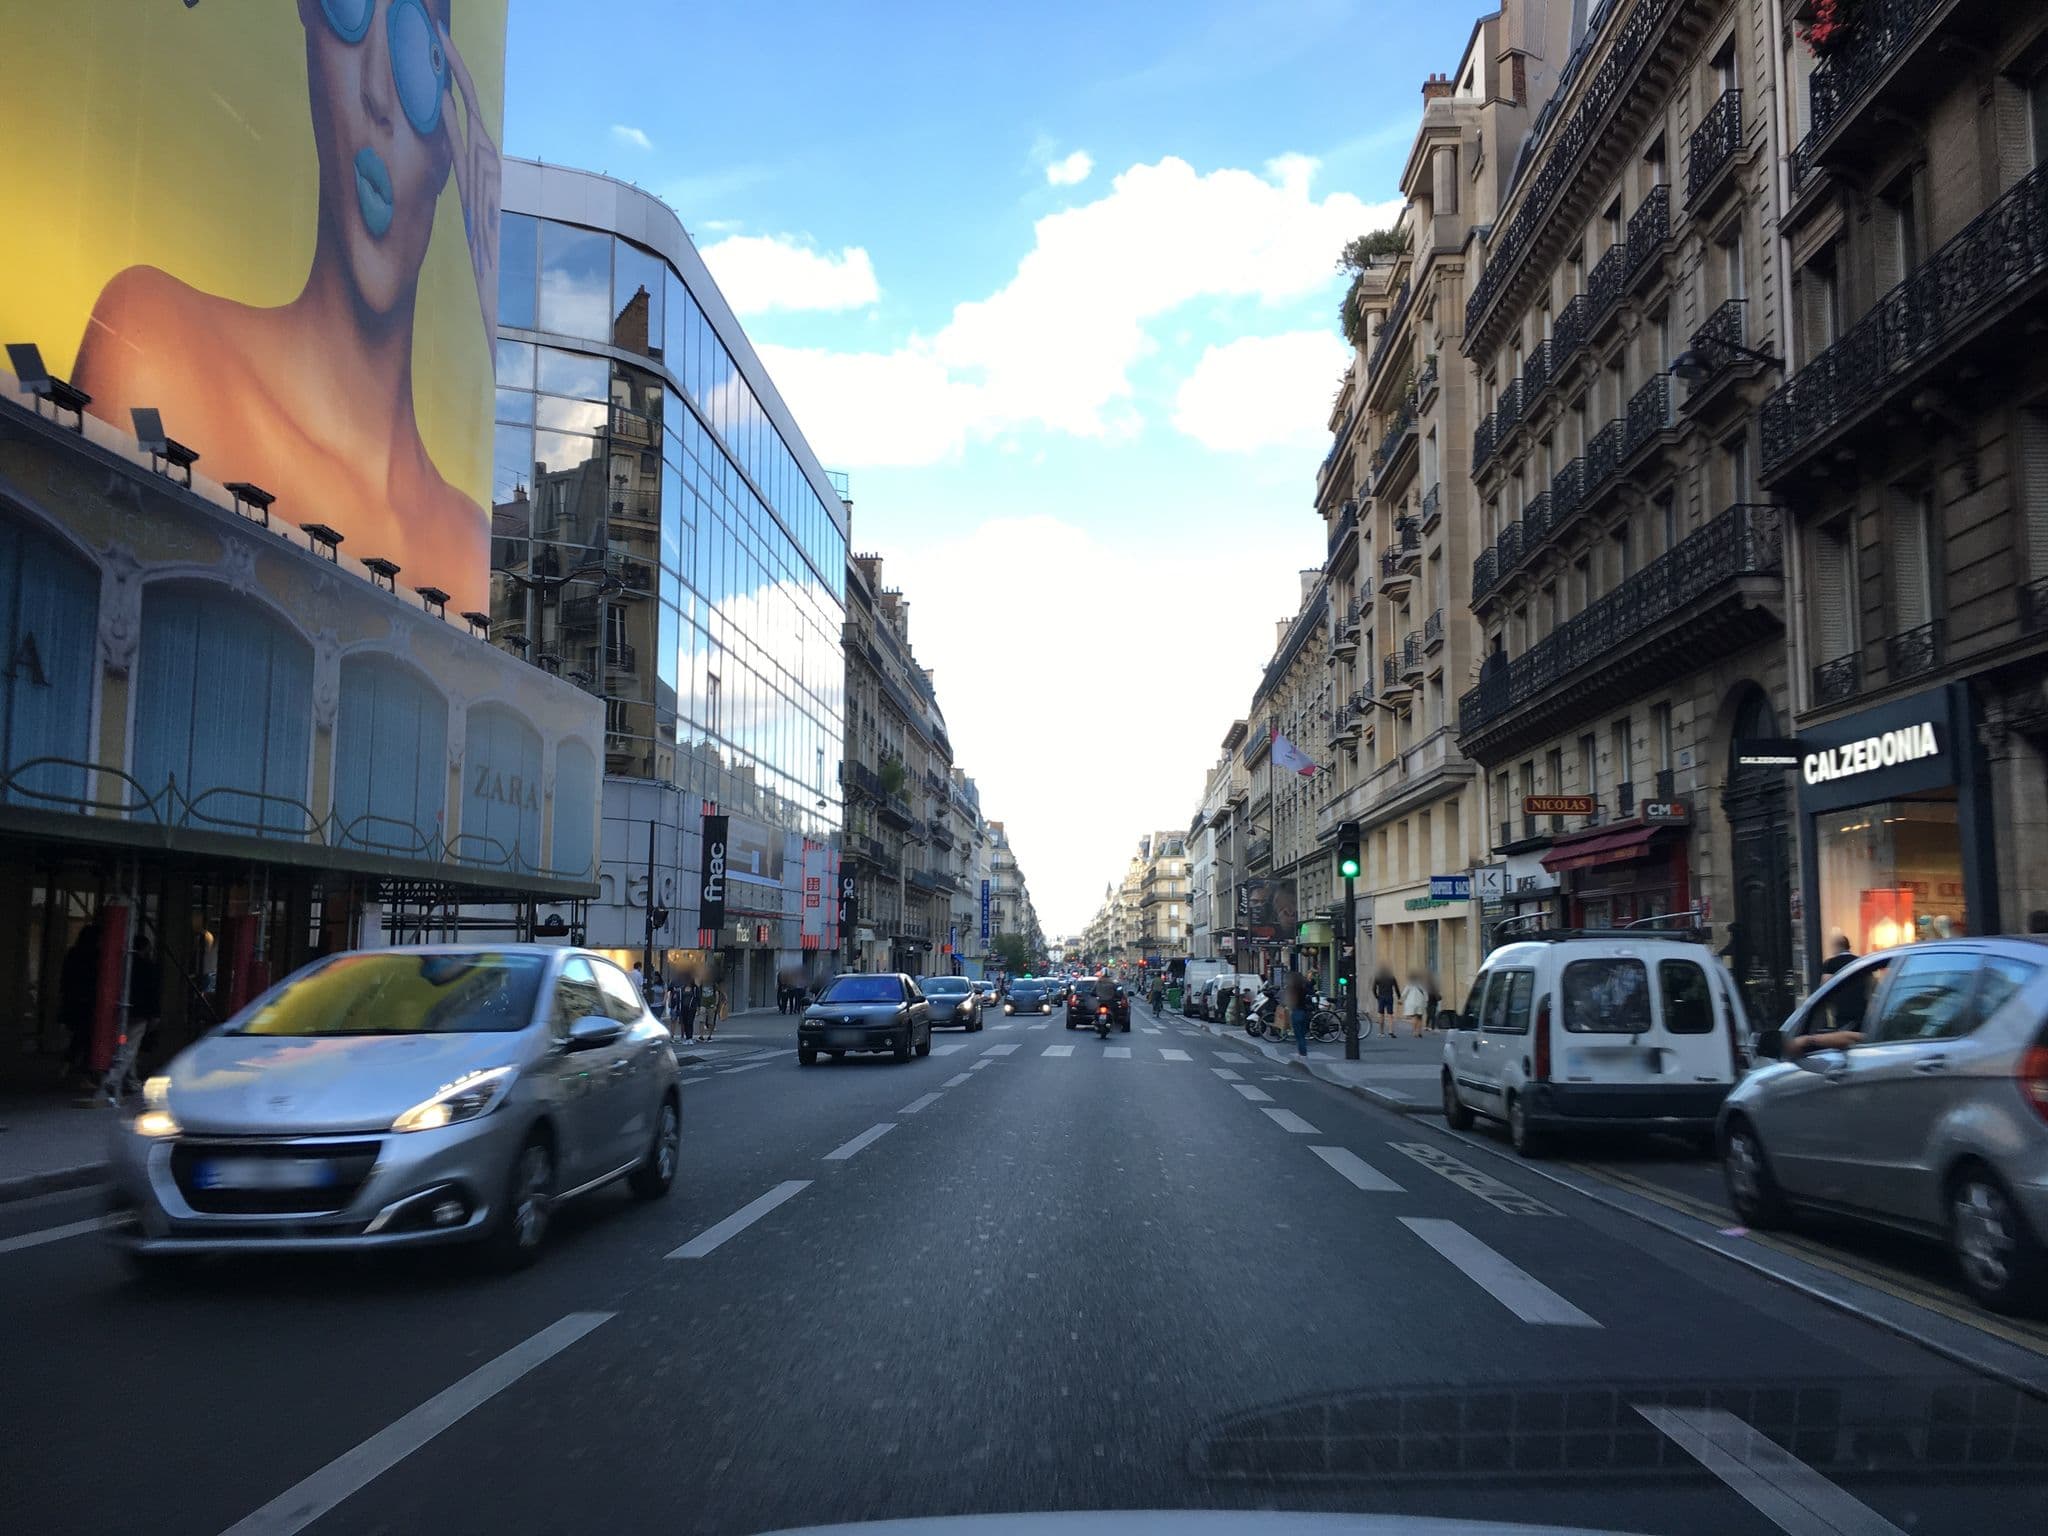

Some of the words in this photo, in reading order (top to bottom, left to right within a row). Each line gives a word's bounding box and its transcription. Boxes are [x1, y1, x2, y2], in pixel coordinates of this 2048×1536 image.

[1739, 756, 1797, 764] CALZEDONIA
[1804, 722, 1938, 784] CALZEDONIA
[474, 764, 540, 812] ZARA
[1532, 800, 1587, 811] NICOLAS
[704, 842, 724, 903] fnac
[1240, 888, 1248, 914] Etam
[736, 923, 750, 942] fnac
